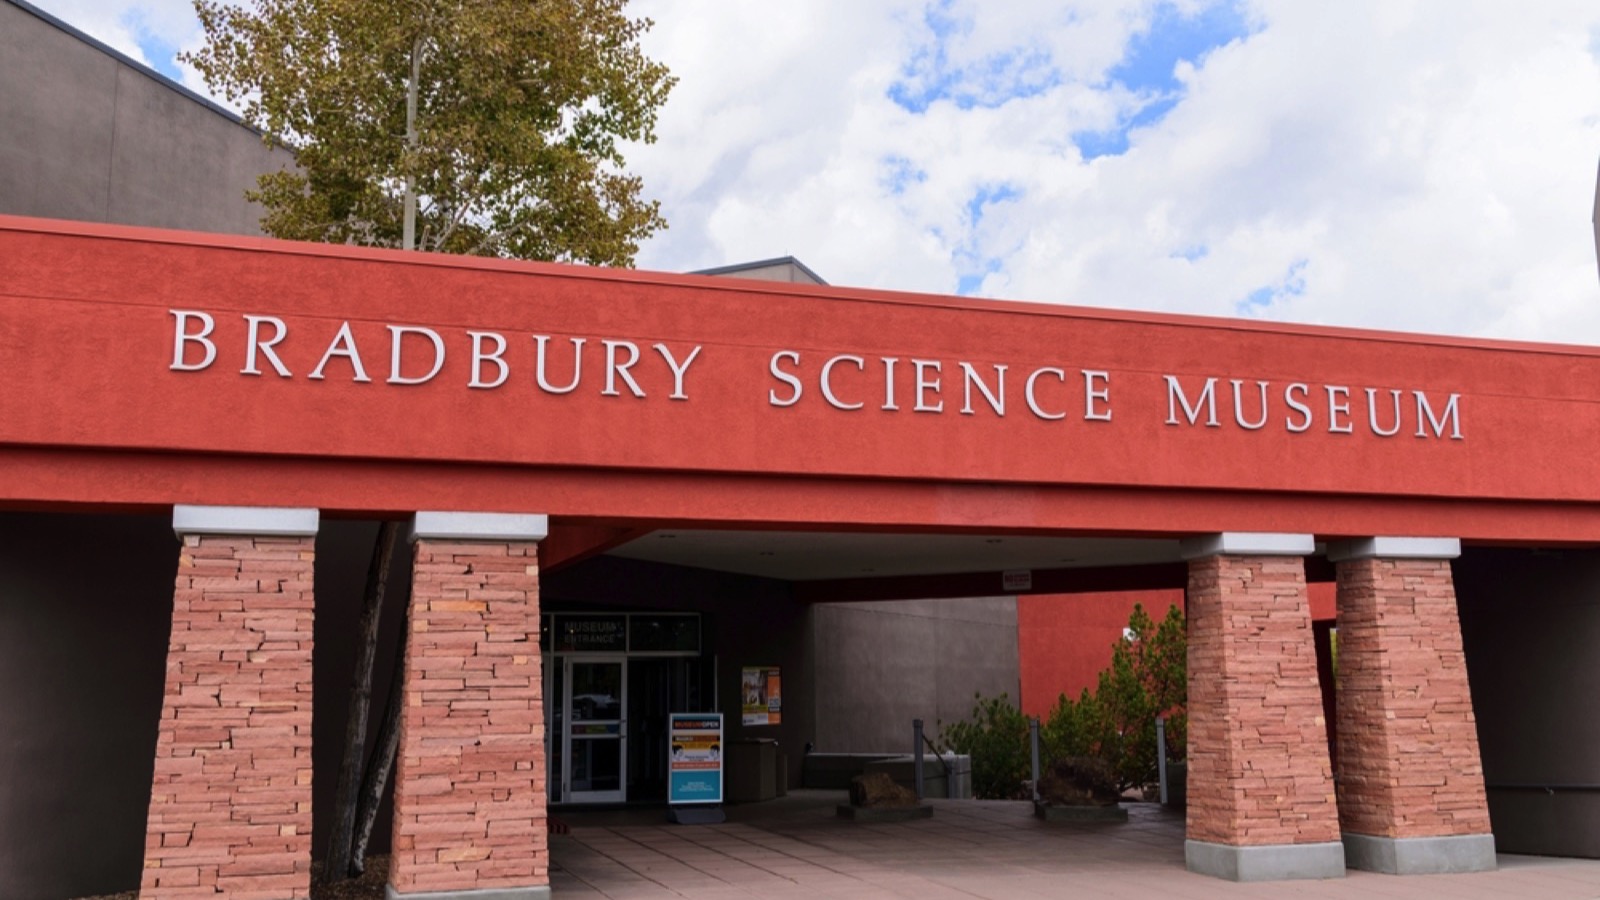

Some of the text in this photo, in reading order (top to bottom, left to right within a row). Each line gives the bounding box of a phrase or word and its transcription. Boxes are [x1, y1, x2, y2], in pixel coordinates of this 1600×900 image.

[168, 308, 1465, 441] BRADBURY SCIENCE MUSEUM
[564, 621, 617, 632] MUSEUM
[564, 634, 615, 643] ENTRANCE
